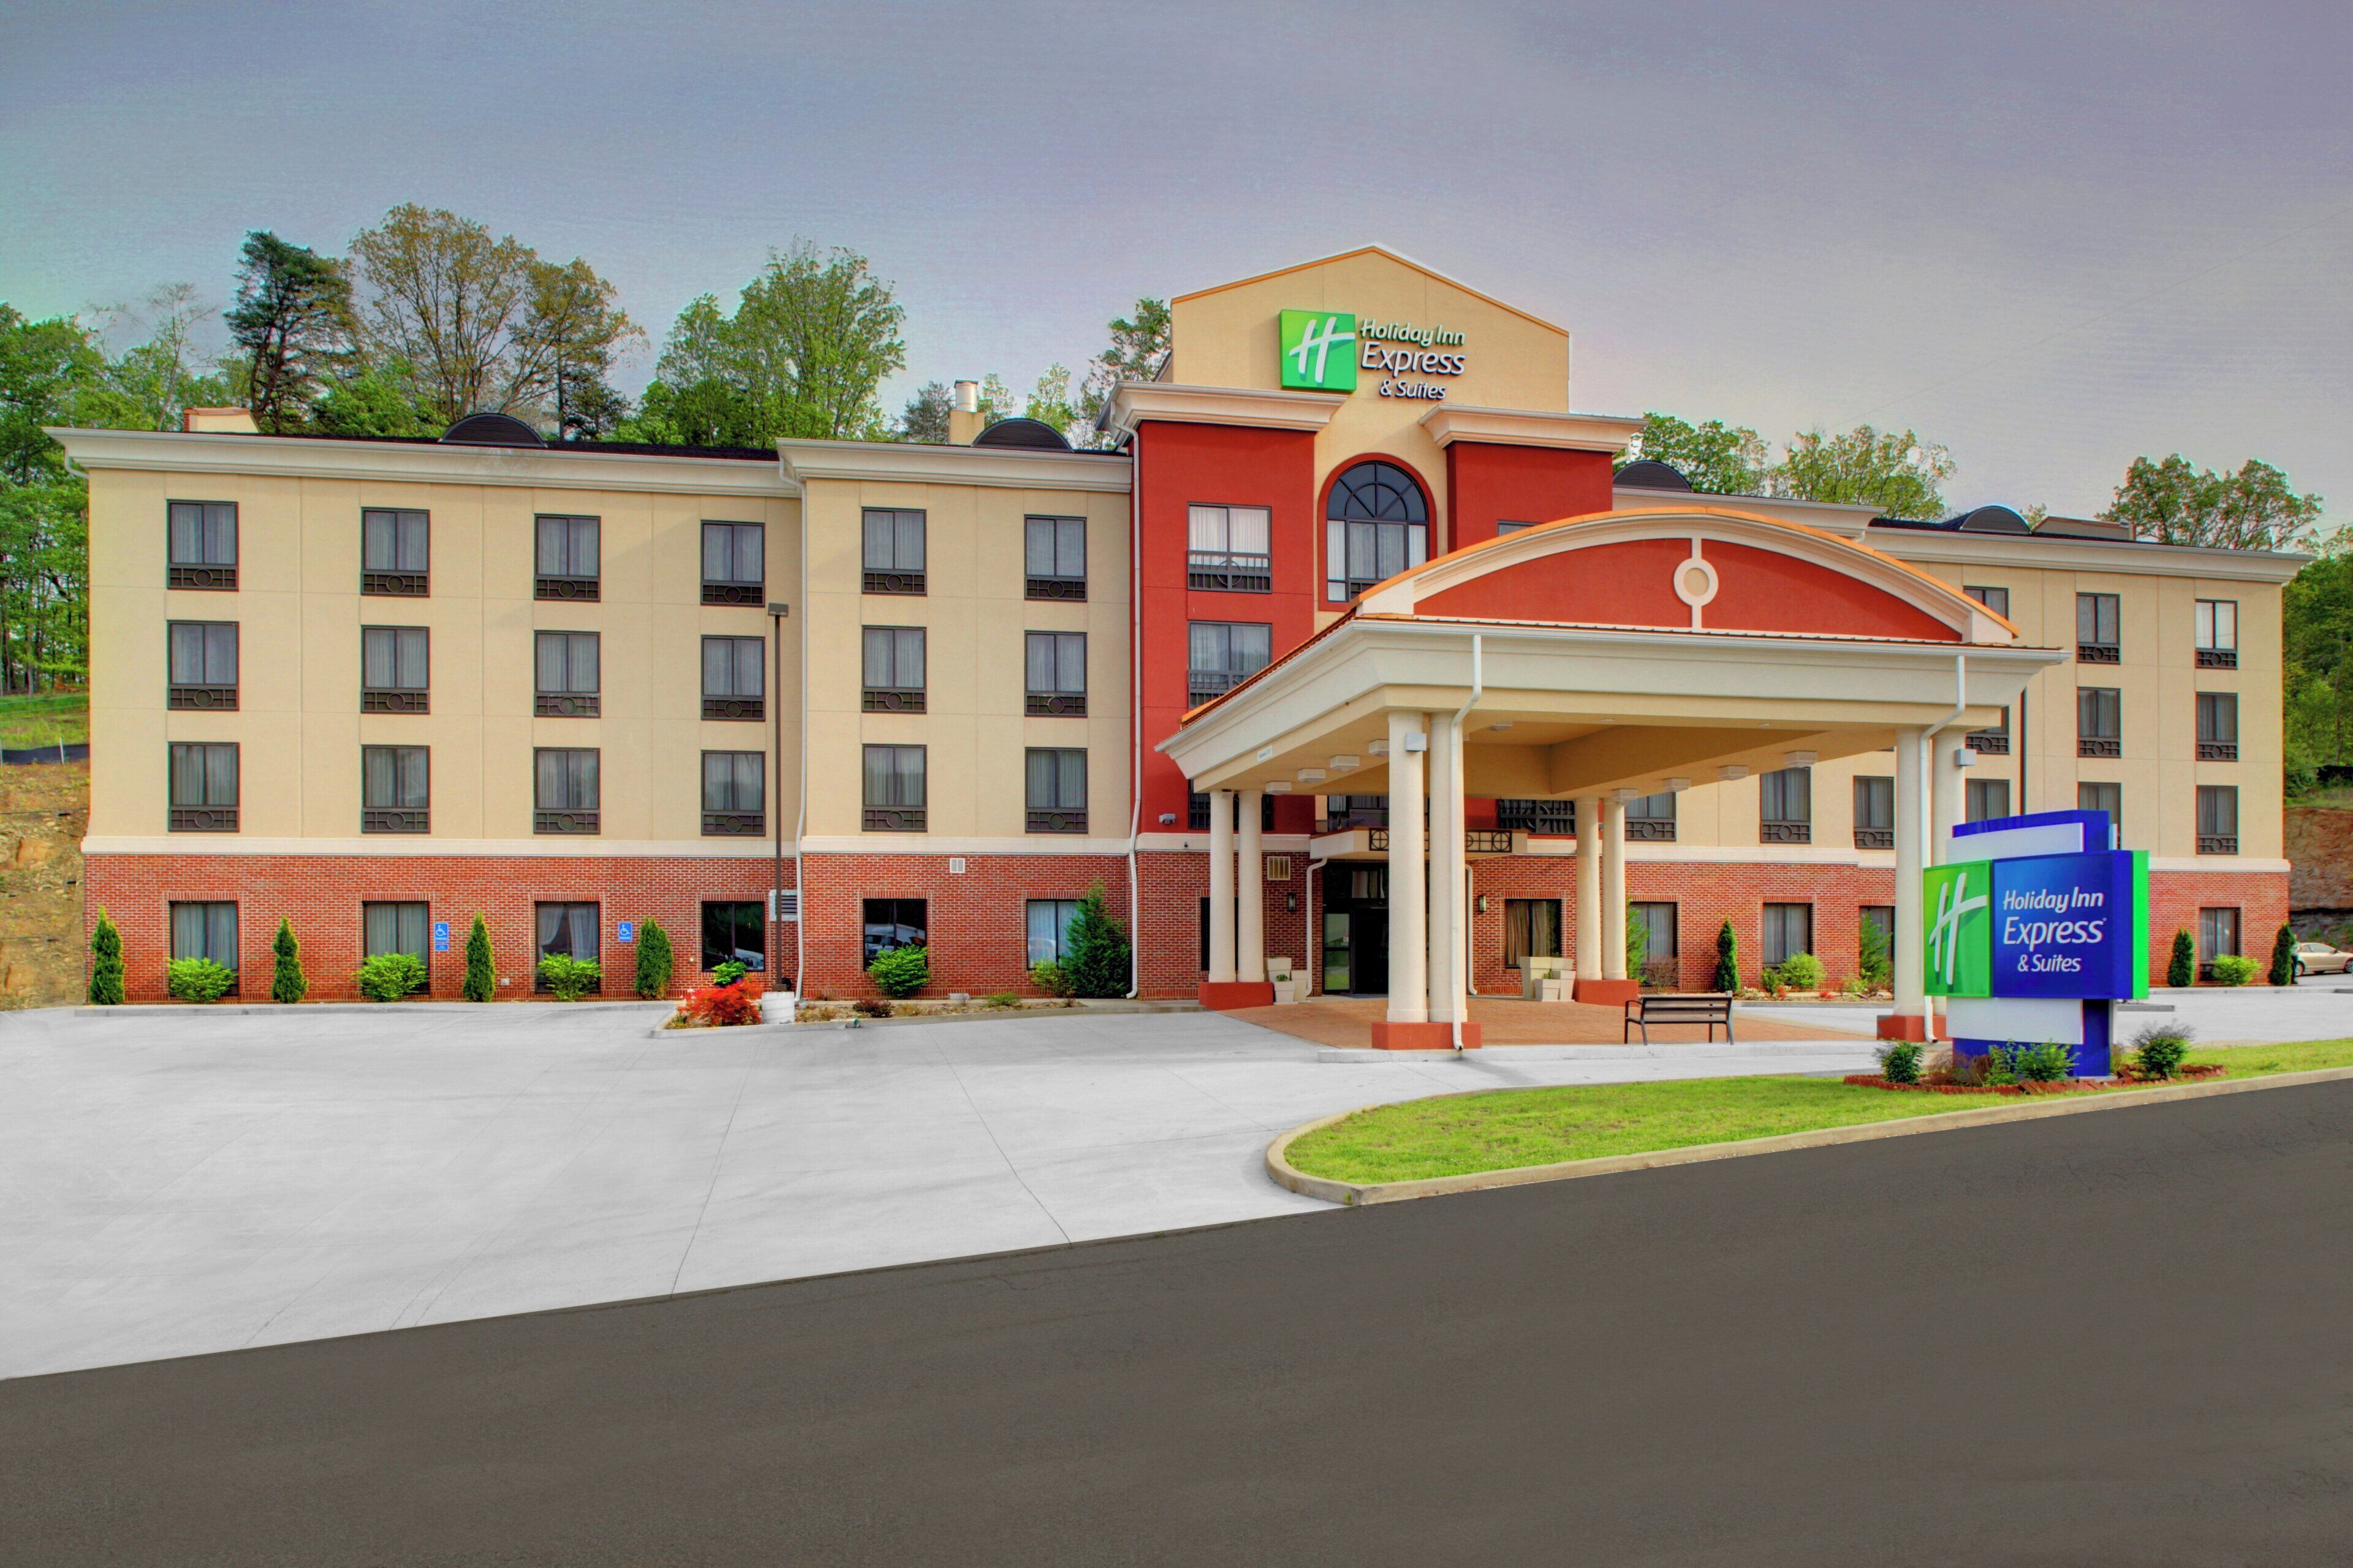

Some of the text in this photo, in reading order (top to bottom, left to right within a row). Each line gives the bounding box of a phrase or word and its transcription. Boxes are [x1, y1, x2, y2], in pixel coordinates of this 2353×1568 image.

[1360, 318, 1465, 347] Holiday Inn
[1361, 341, 1466, 377] Express
[1379, 379, 1446, 399] & Suites
[2003, 886, 2104, 913] Holiday Inn
[2003, 916, 2104, 952] Express
[2017, 954, 2082, 972] & Suites
